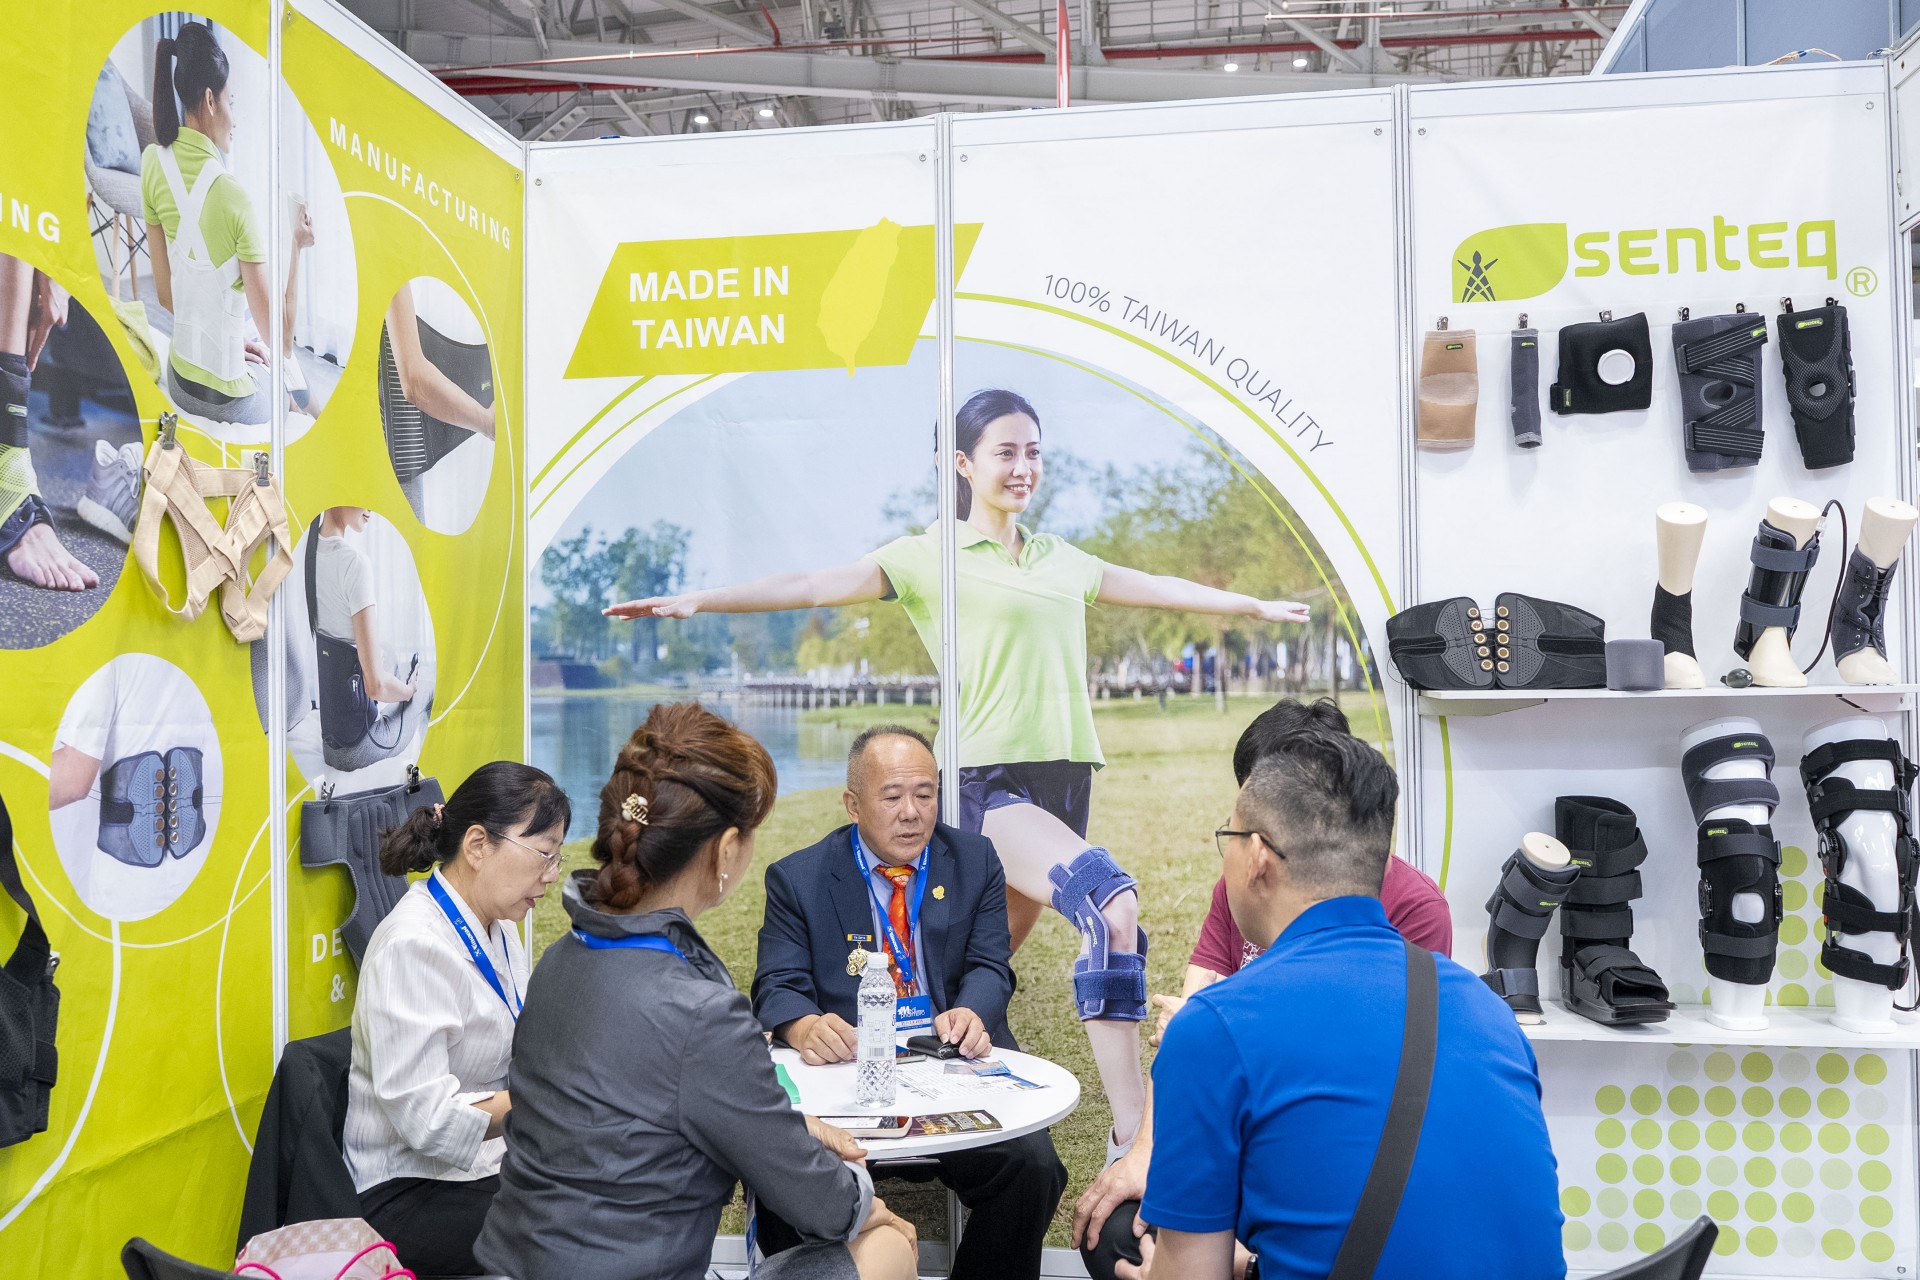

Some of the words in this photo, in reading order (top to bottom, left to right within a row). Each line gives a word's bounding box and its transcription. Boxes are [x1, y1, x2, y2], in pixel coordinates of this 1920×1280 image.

[329, 117, 511, 251] MANUFACTURING
[629, 267, 739, 302] MADE
[753, 265, 789, 297] IN
[632, 313, 785, 349] TAIWAN
[1045, 274, 1111, 313] 100%
[1121, 295, 1226, 366] TAIWAN
[1226, 358, 1334, 453] QUALITY
[330, 973, 345, 1003] &
